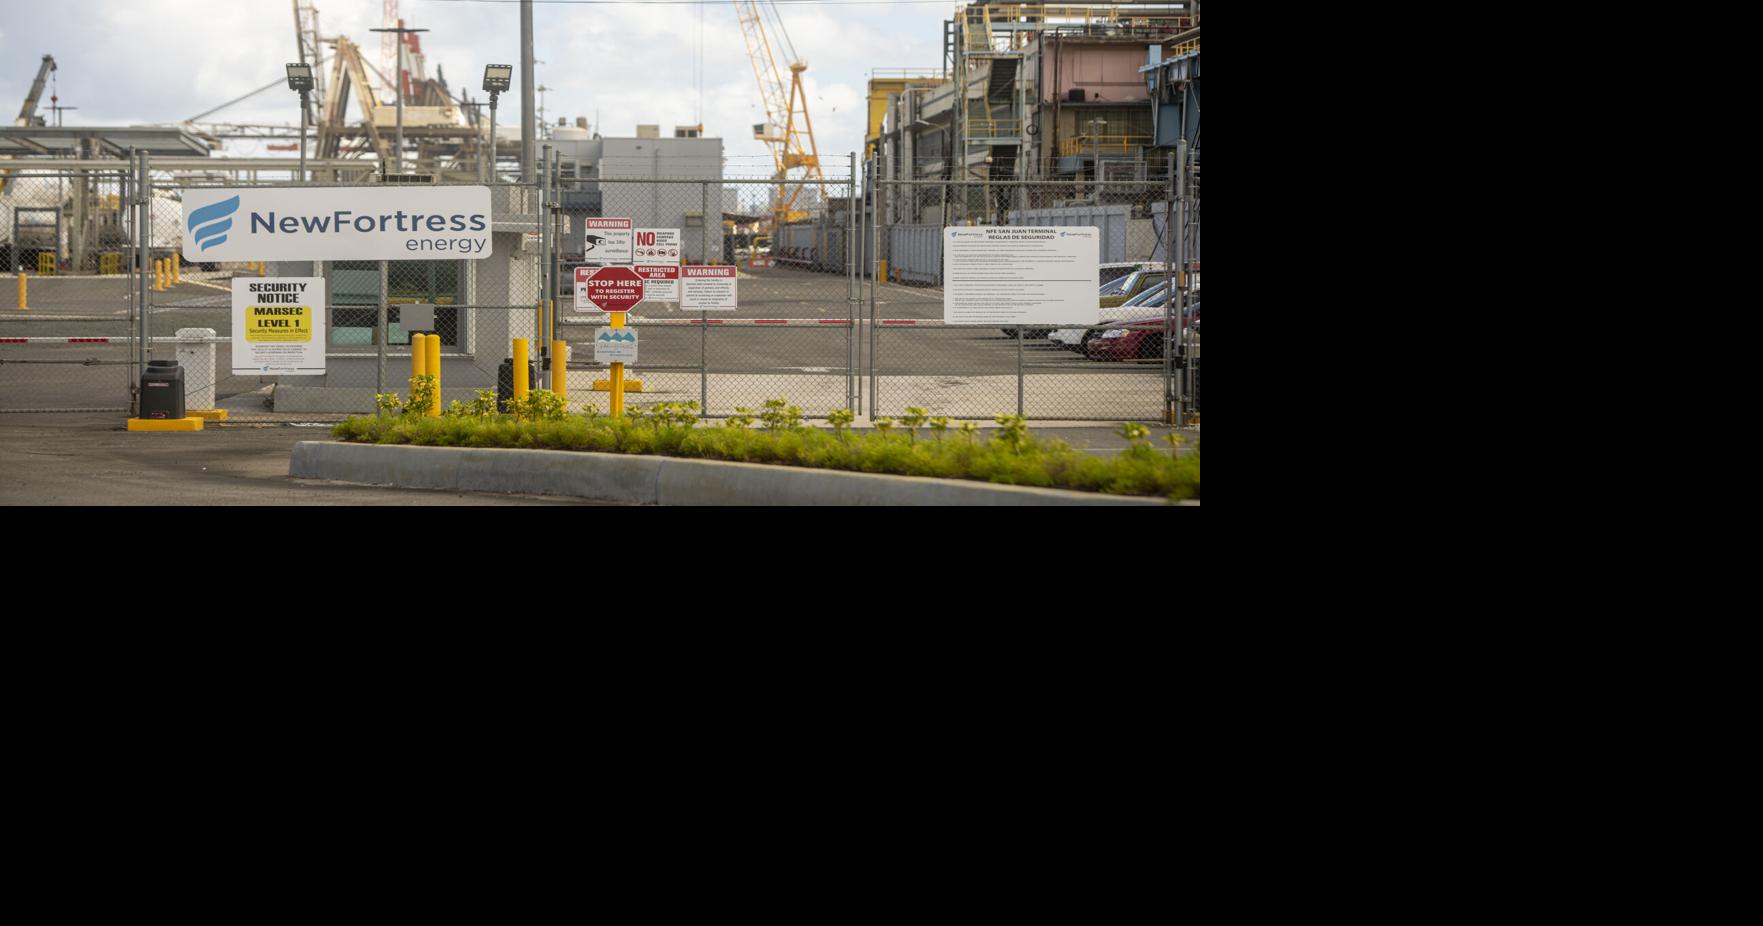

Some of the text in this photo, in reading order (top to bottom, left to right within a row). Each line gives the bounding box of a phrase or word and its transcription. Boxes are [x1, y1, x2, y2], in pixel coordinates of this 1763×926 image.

[251, 210, 486, 234] NewFortress
[589, 220, 629, 228] WARNING
[637, 231, 656, 246] NO
[405, 237, 487, 253] energy
[687, 268, 730, 276] WARNING
[249, 283, 307, 292] SECURITY
[258, 293, 299, 303] NOTICE
[254, 307, 303, 316] MARSEC
[258, 319, 299, 327] LEVEL 1
